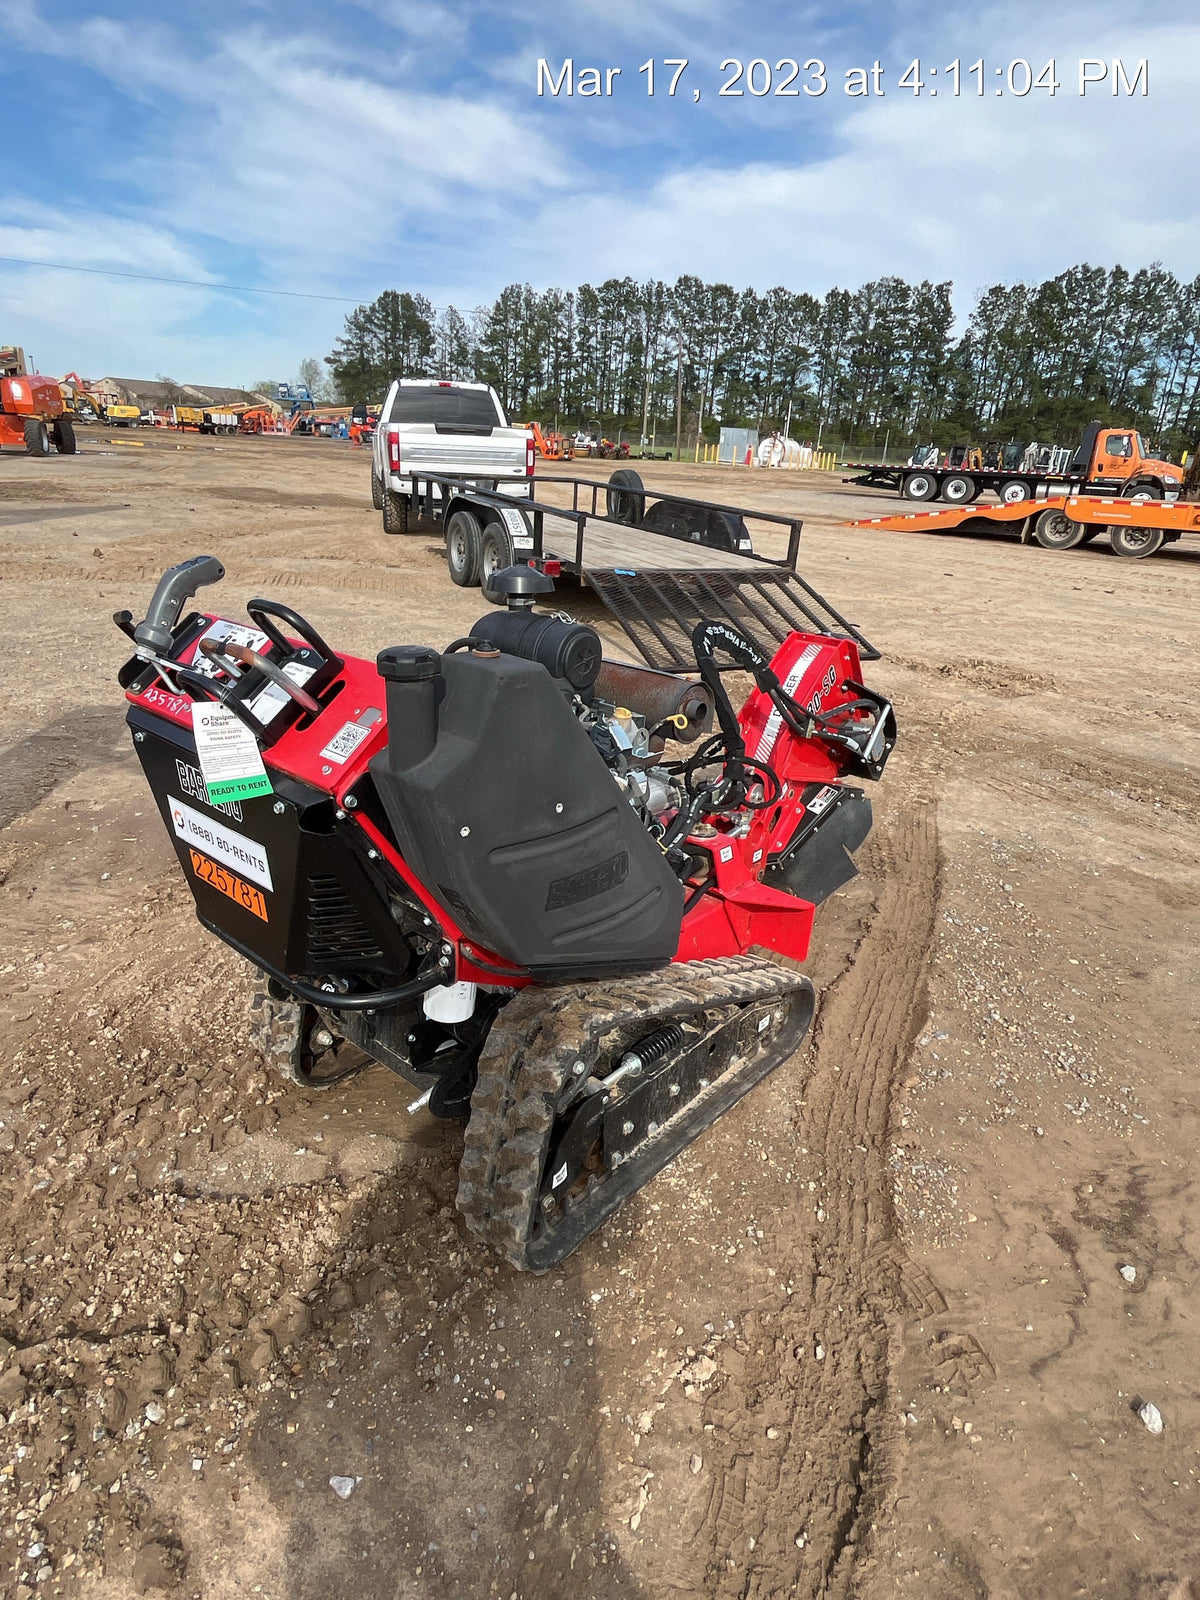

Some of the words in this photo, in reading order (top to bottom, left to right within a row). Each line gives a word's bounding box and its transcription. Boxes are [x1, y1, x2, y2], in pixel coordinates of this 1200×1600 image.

[210, 786, 235, 797] READY
[236, 784, 247, 792] TO
[248, 780, 268, 790] RENT
[188, 820, 215, 845] (888)
[216, 836, 266, 873] 80-RENTS
[192, 851, 264, 917] 225781
